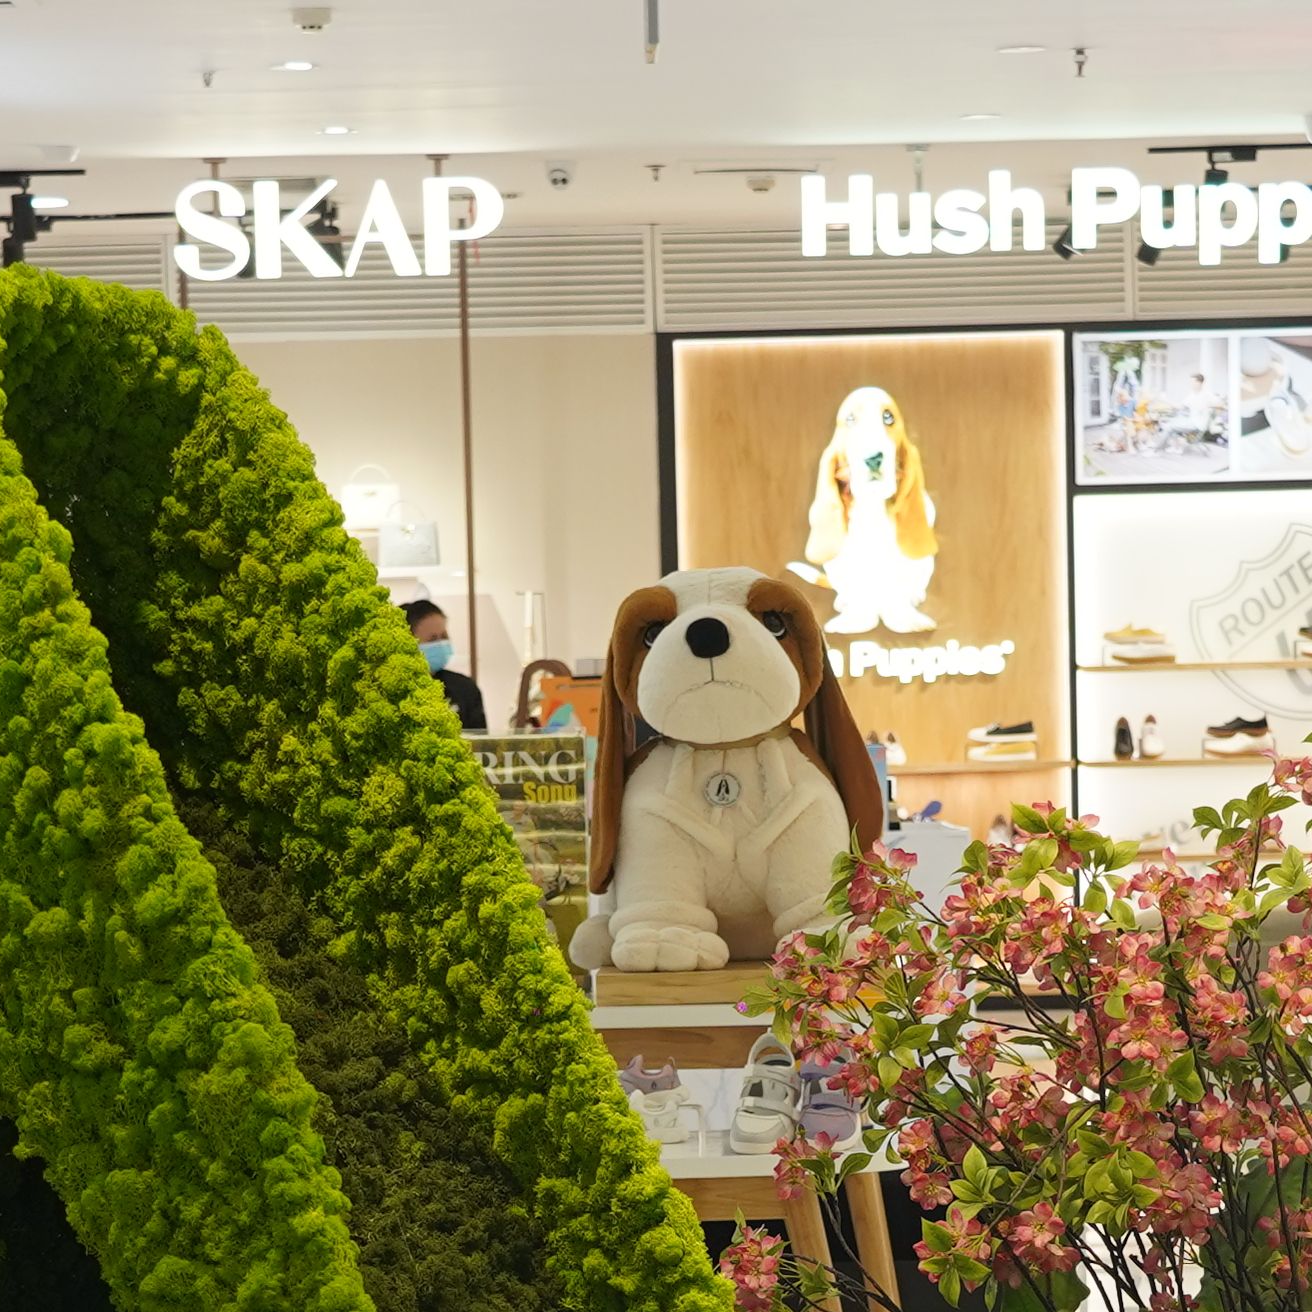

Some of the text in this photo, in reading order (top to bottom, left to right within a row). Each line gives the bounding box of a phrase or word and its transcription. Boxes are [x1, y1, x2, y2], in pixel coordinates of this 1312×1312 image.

[173, 177, 504, 281] SKAP
[800, 169, 1045, 257] Hush
[849, 640, 1006, 684] Puppies
[474, 750, 577, 785] RING
